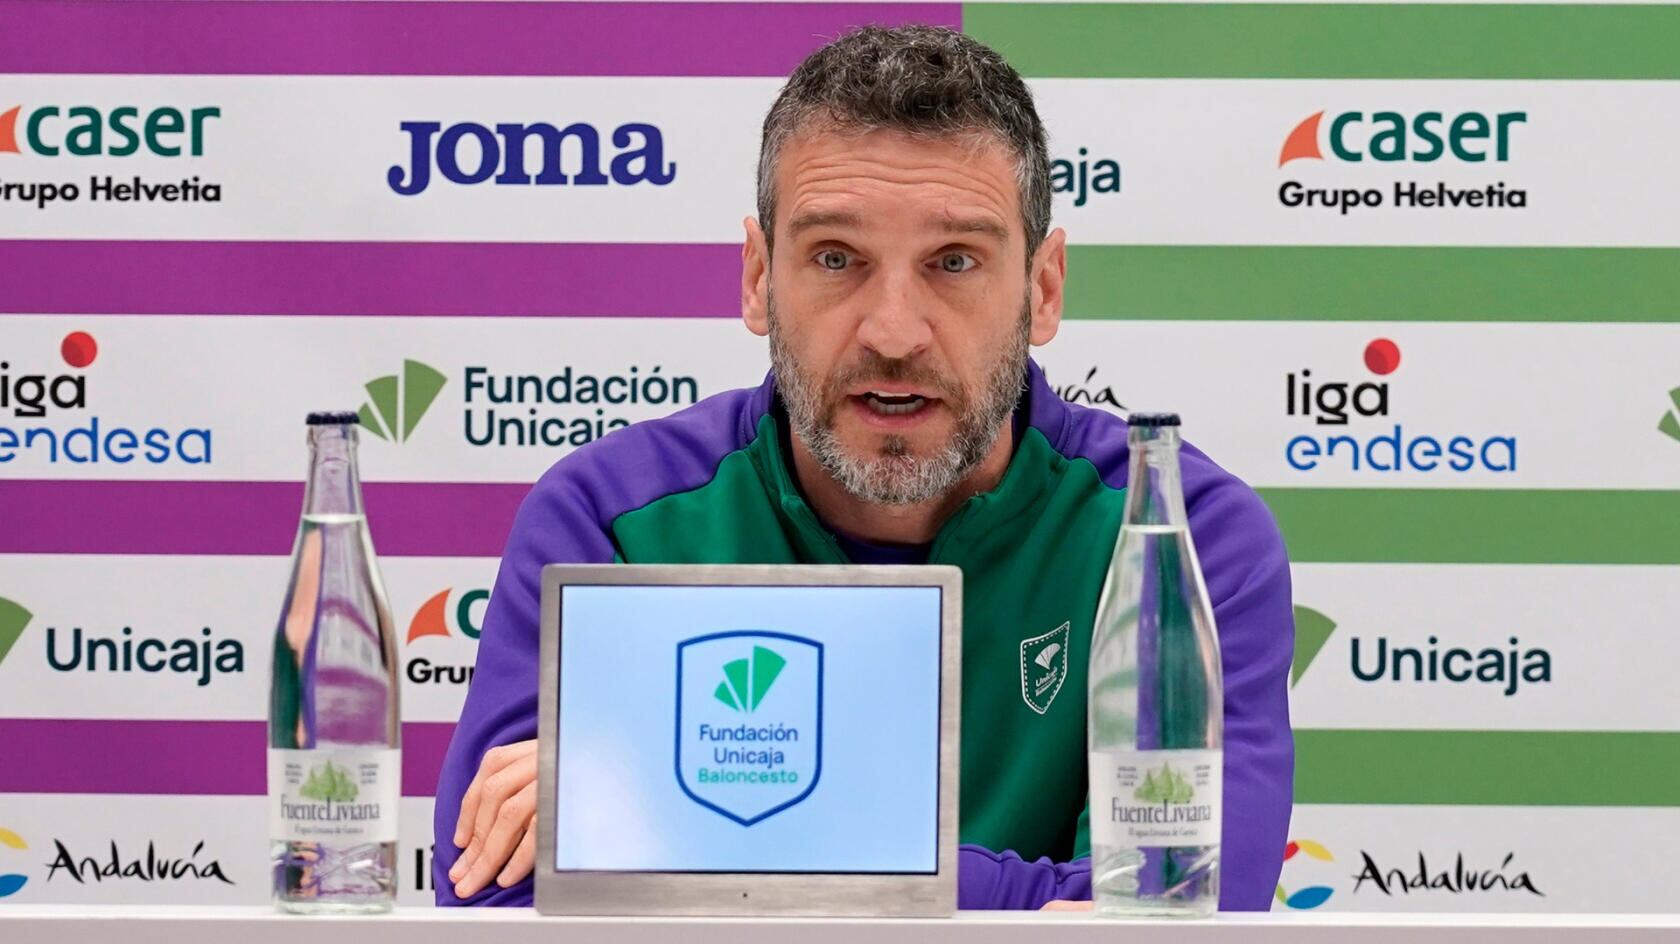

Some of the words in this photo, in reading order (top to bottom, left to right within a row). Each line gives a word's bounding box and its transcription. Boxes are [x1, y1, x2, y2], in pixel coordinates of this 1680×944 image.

[25, 105, 222, 158] caser
[1328, 110, 1528, 164] caser
[0, 179, 80, 210] rupo
[89, 175, 222, 203] Helvetia
[1277, 180, 1384, 216] Grupo
[1393, 181, 1527, 209] Helvetia
[464, 366, 699, 404] Fundación
[1285, 370, 1389, 425] liga
[1285, 422, 1517, 473] endesa
[45, 626, 245, 687] Unicaja
[1350, 635, 1552, 697] Unicaja
[697, 722, 800, 743] Fundación
[698, 768, 799, 783] Baloncesto
[714, 746, 785, 768] Unicaja
[280, 793, 381, 823] FuenteLiviana
[1111, 797, 1212, 823] FuenteLiviana
[44, 838, 235, 885] Andalucía
[1351, 850, 1544, 897] Andalucía
